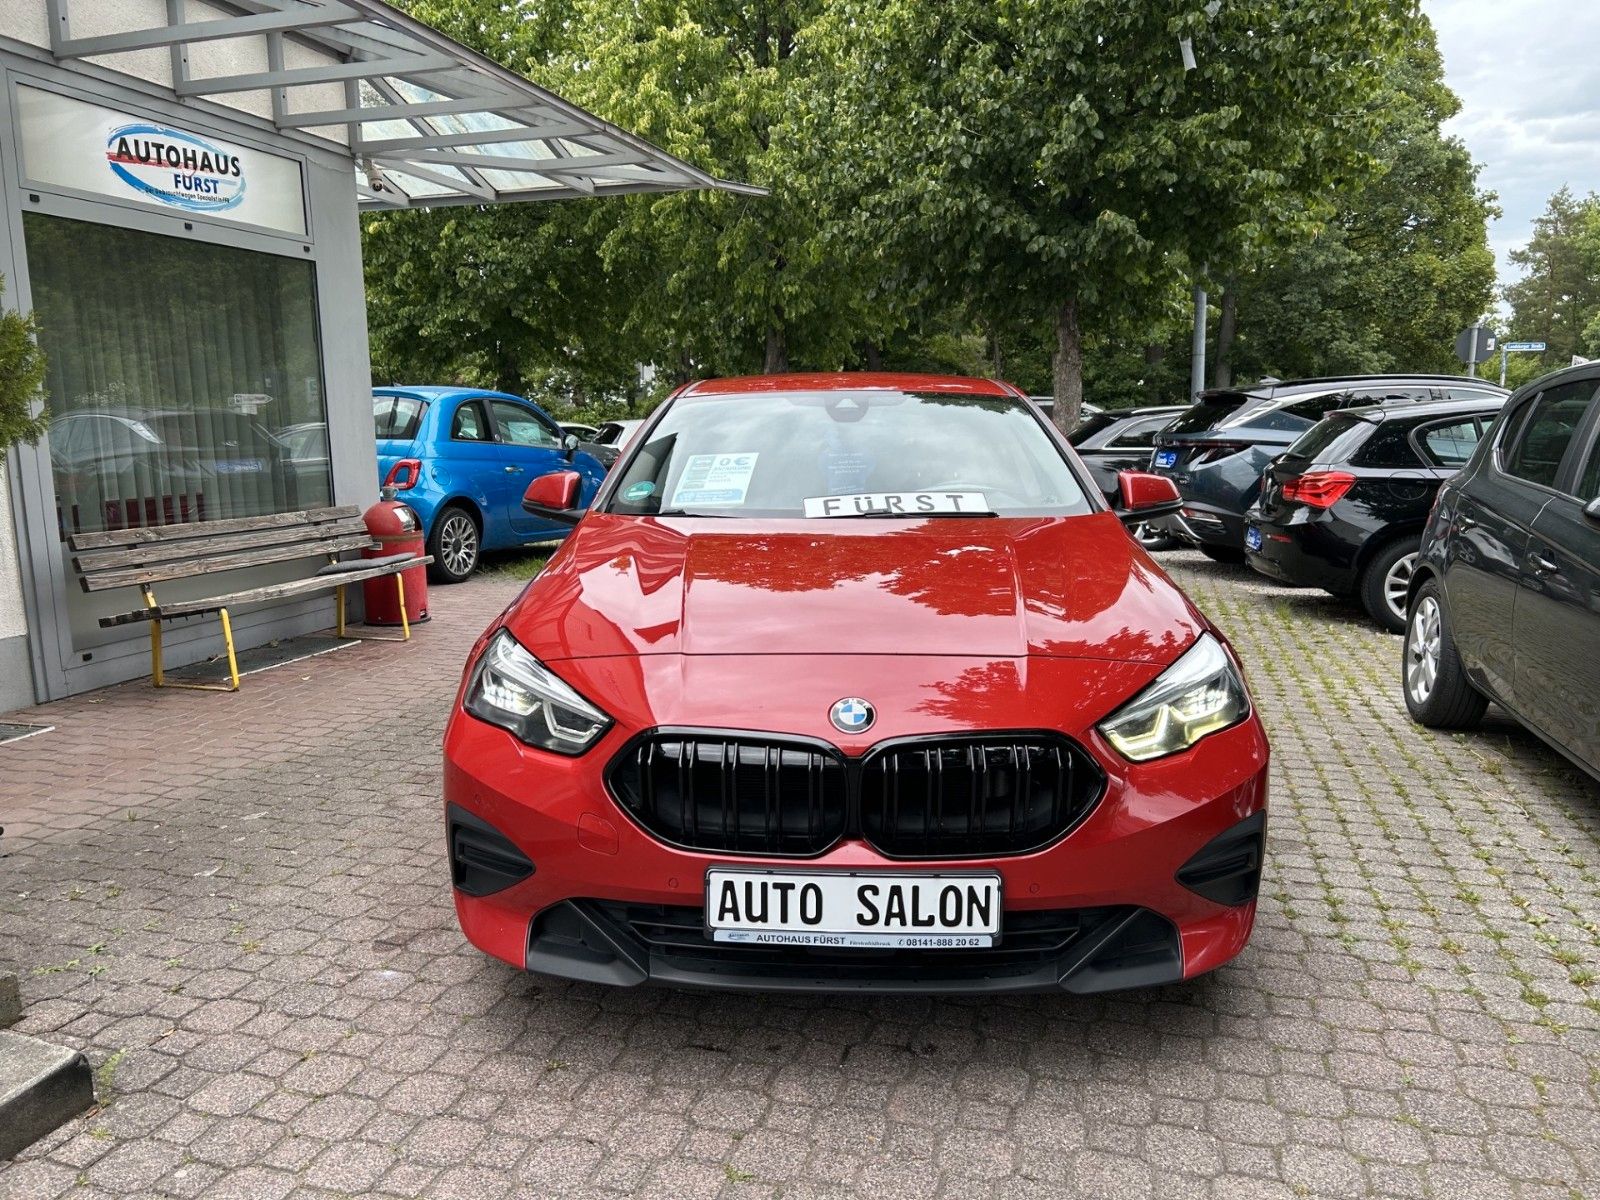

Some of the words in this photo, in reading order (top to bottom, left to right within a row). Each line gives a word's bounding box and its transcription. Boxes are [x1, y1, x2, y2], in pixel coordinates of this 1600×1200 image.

[116, 137, 241, 177] AUTOHAUS
[823, 494, 964, 516] FÜRST
[718, 880, 823, 925] AUTO
[856, 884, 991, 927] SALON
[756, 934, 811, 944] AUTOHAUS
[813, 935, 846, 945] FÜRST
[906, 938, 953, 946] 08141-888
[956, 938, 967, 946] 20
[969, 938, 980, 946] 62
